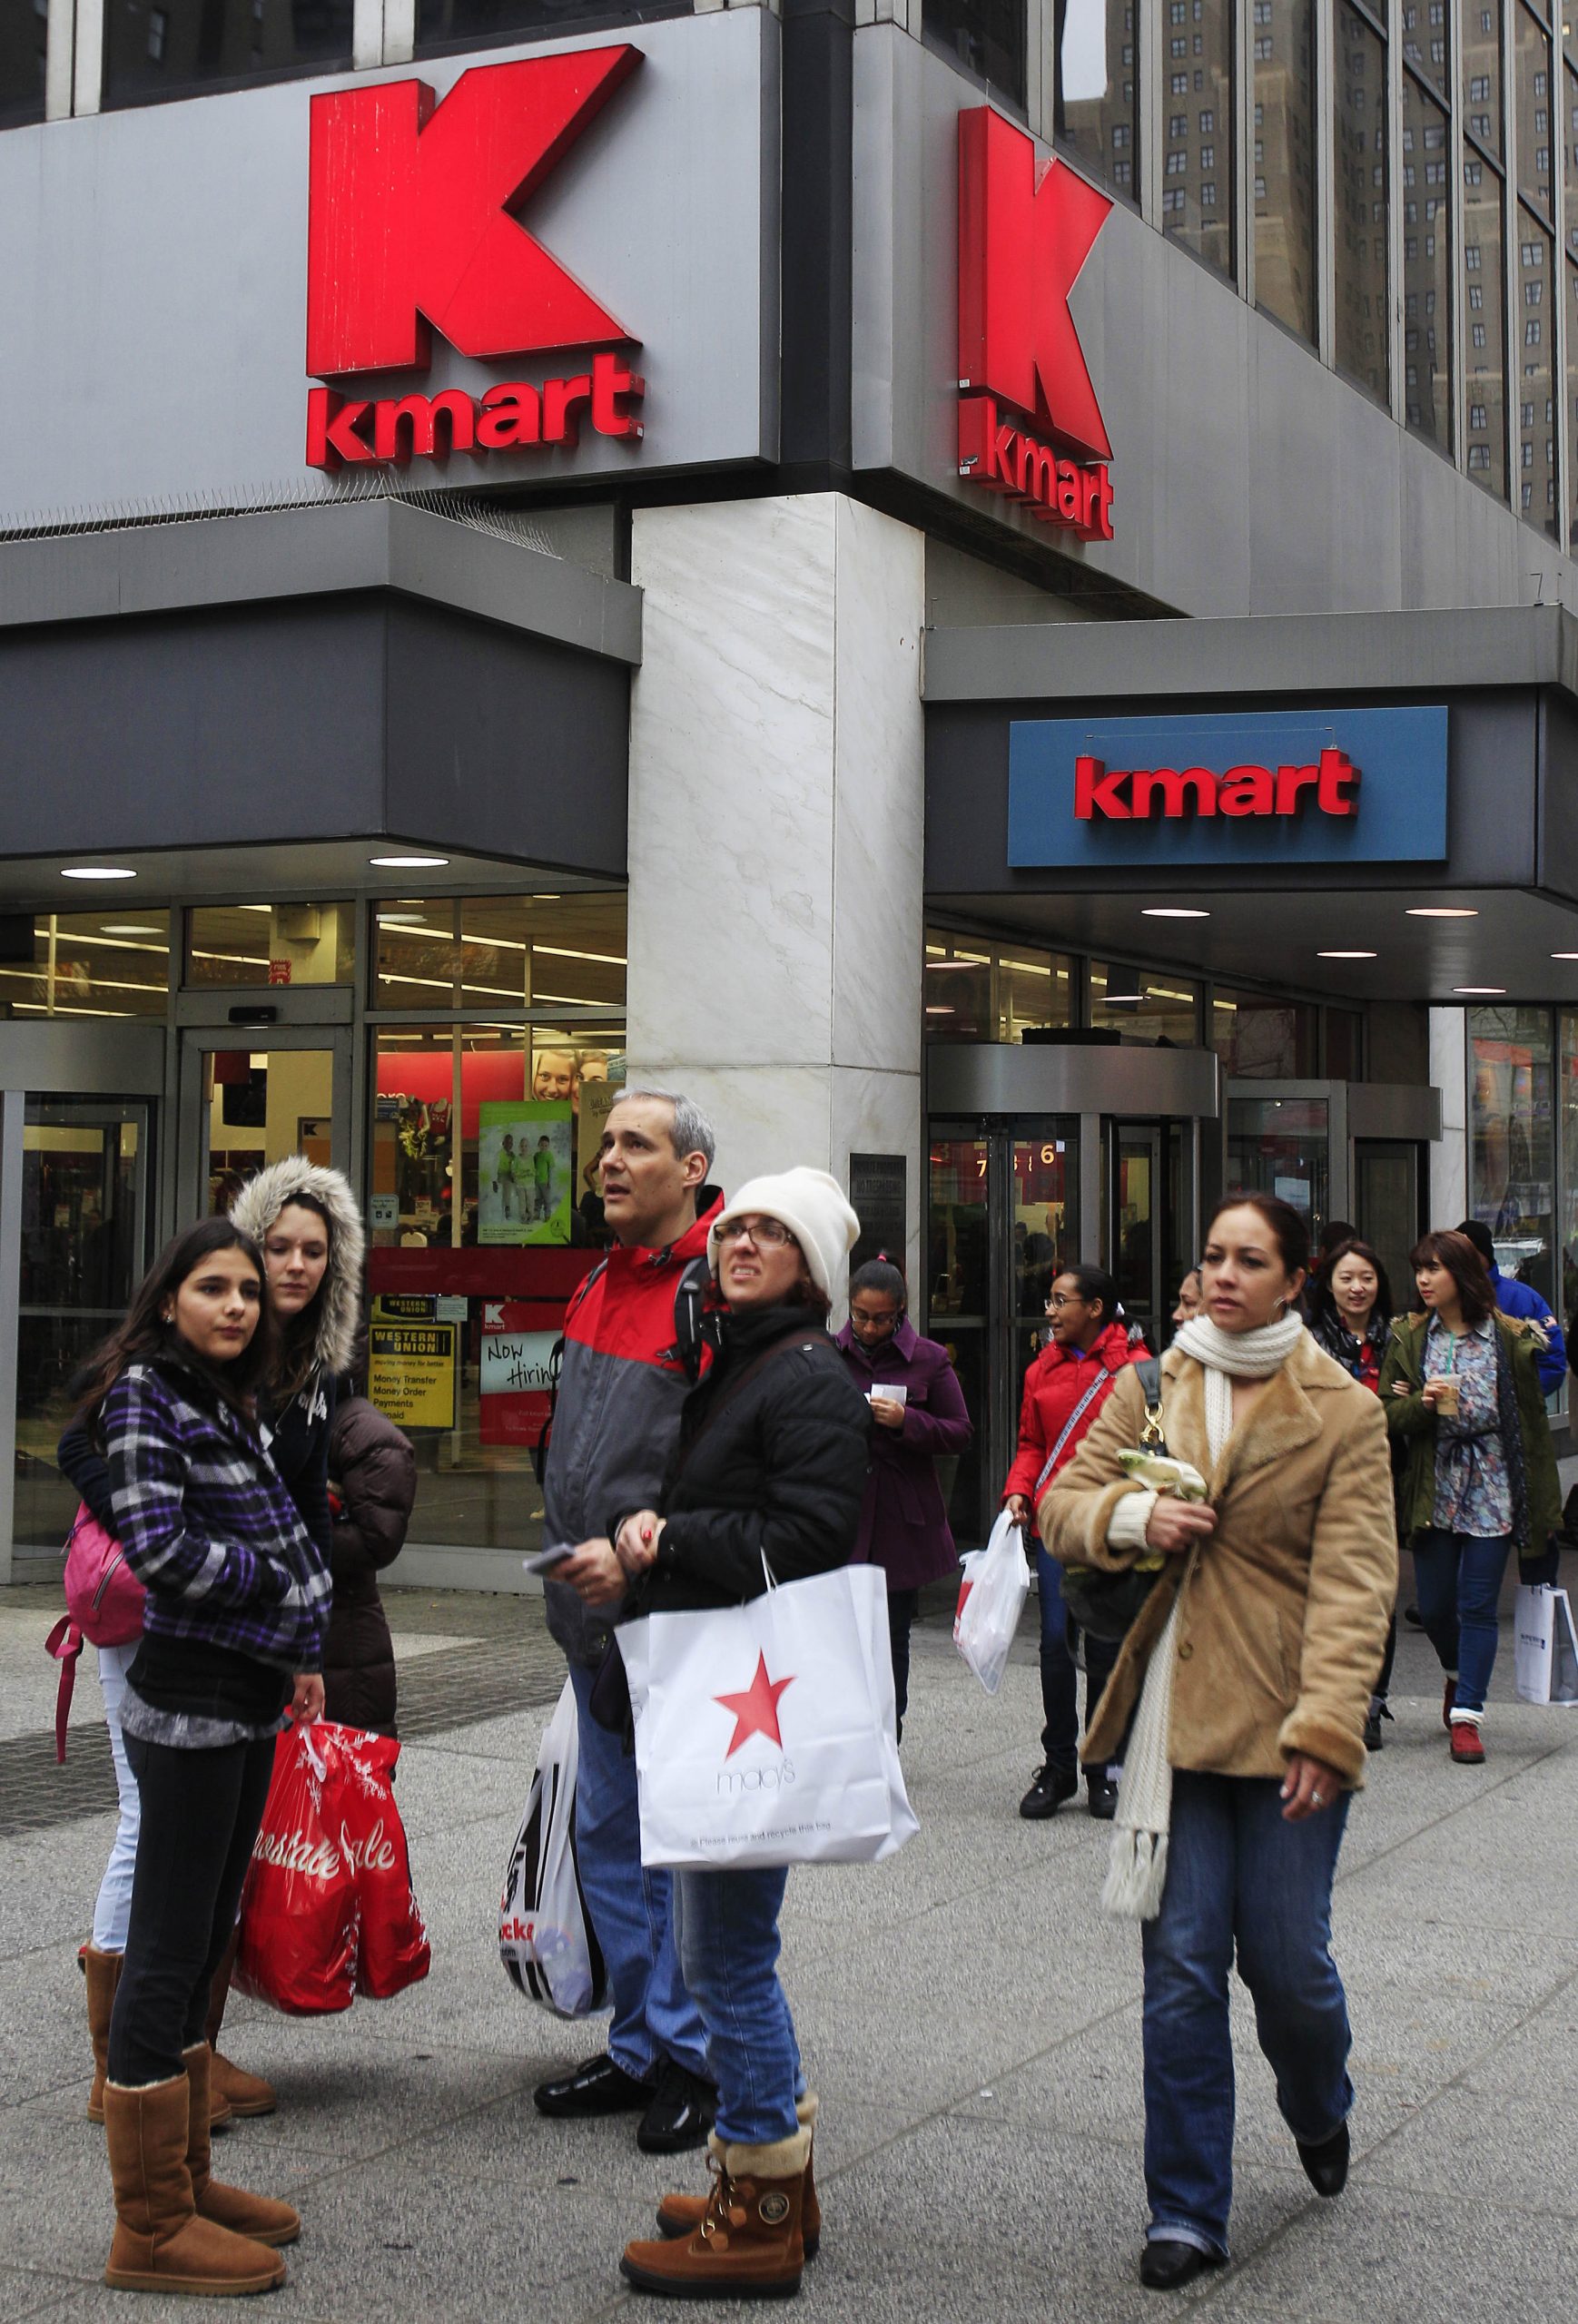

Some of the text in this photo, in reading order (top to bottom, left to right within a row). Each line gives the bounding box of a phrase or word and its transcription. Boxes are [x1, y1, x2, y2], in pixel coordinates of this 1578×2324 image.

[307, 44, 644, 378] K
[959, 106, 1114, 461] K
[307, 354, 644, 470] kmart
[959, 397, 1114, 542] kmart
[1075, 748, 1361, 819] kmart
[1040, 1145, 1054, 1164] 6
[976, 1160, 987, 1177] 7
[389, 1299, 427, 1307] WESTERN
[485, 1304, 506, 1324] K
[375, 1331, 437, 1343] WESTERN
[394, 1342, 437, 1353] UNION
[488, 1336, 523, 1361] Now
[373, 1374, 437, 1384] Money Transfer
[373, 1385, 427, 1397] Money Order
[373, 1398, 413, 1408] Payments
[699, 1837, 726, 1847] Please
[749, 1832, 765, 1842] and
[766, 1826, 797, 1839] recycle
